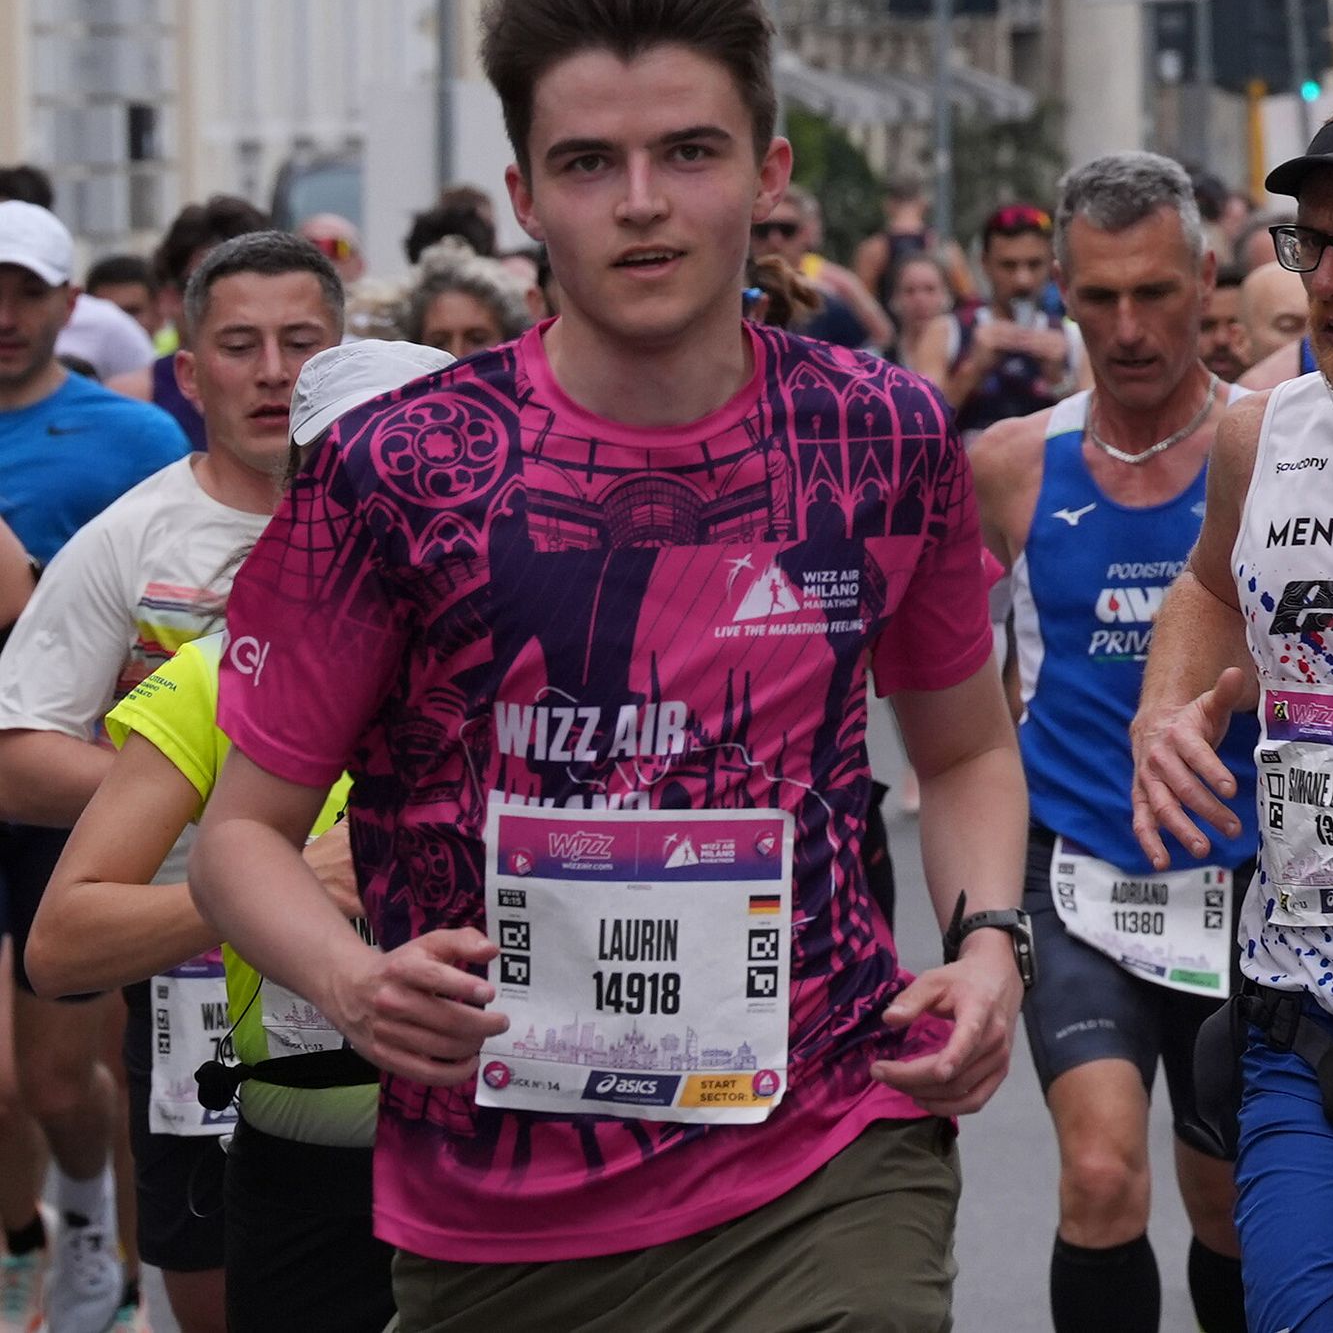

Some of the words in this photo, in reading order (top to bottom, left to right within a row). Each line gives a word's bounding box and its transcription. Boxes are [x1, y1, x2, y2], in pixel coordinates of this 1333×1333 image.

[1276, 457, 1329, 474] saucony
[803, 571, 838, 583] WIZZ
[840, 569, 860, 582] AIR
[1107, 561, 1185, 580] PODISTIC
[803, 583, 860, 598] MILANO
[803, 598, 858, 609] MARATHON
[715, 625, 740, 638] LIVE
[745, 624, 767, 637] THE
[768, 622, 828, 636] MARATHON
[830, 618, 864, 633] FEELING
[1088, 630, 1153, 655] PRIV
[495, 701, 601, 762] WIZZ
[610, 700, 688, 758] AIR
[1111, 881, 1169, 906] ADRIANO
[1113, 911, 1165, 935] 11380
[598, 918, 679, 961] LAURIN
[592, 971, 681, 1015] 14918
[615, 1078, 658, 1095] asics
[700, 1079, 736, 1090] START
[700, 1092, 749, 1102] SECTOR:
